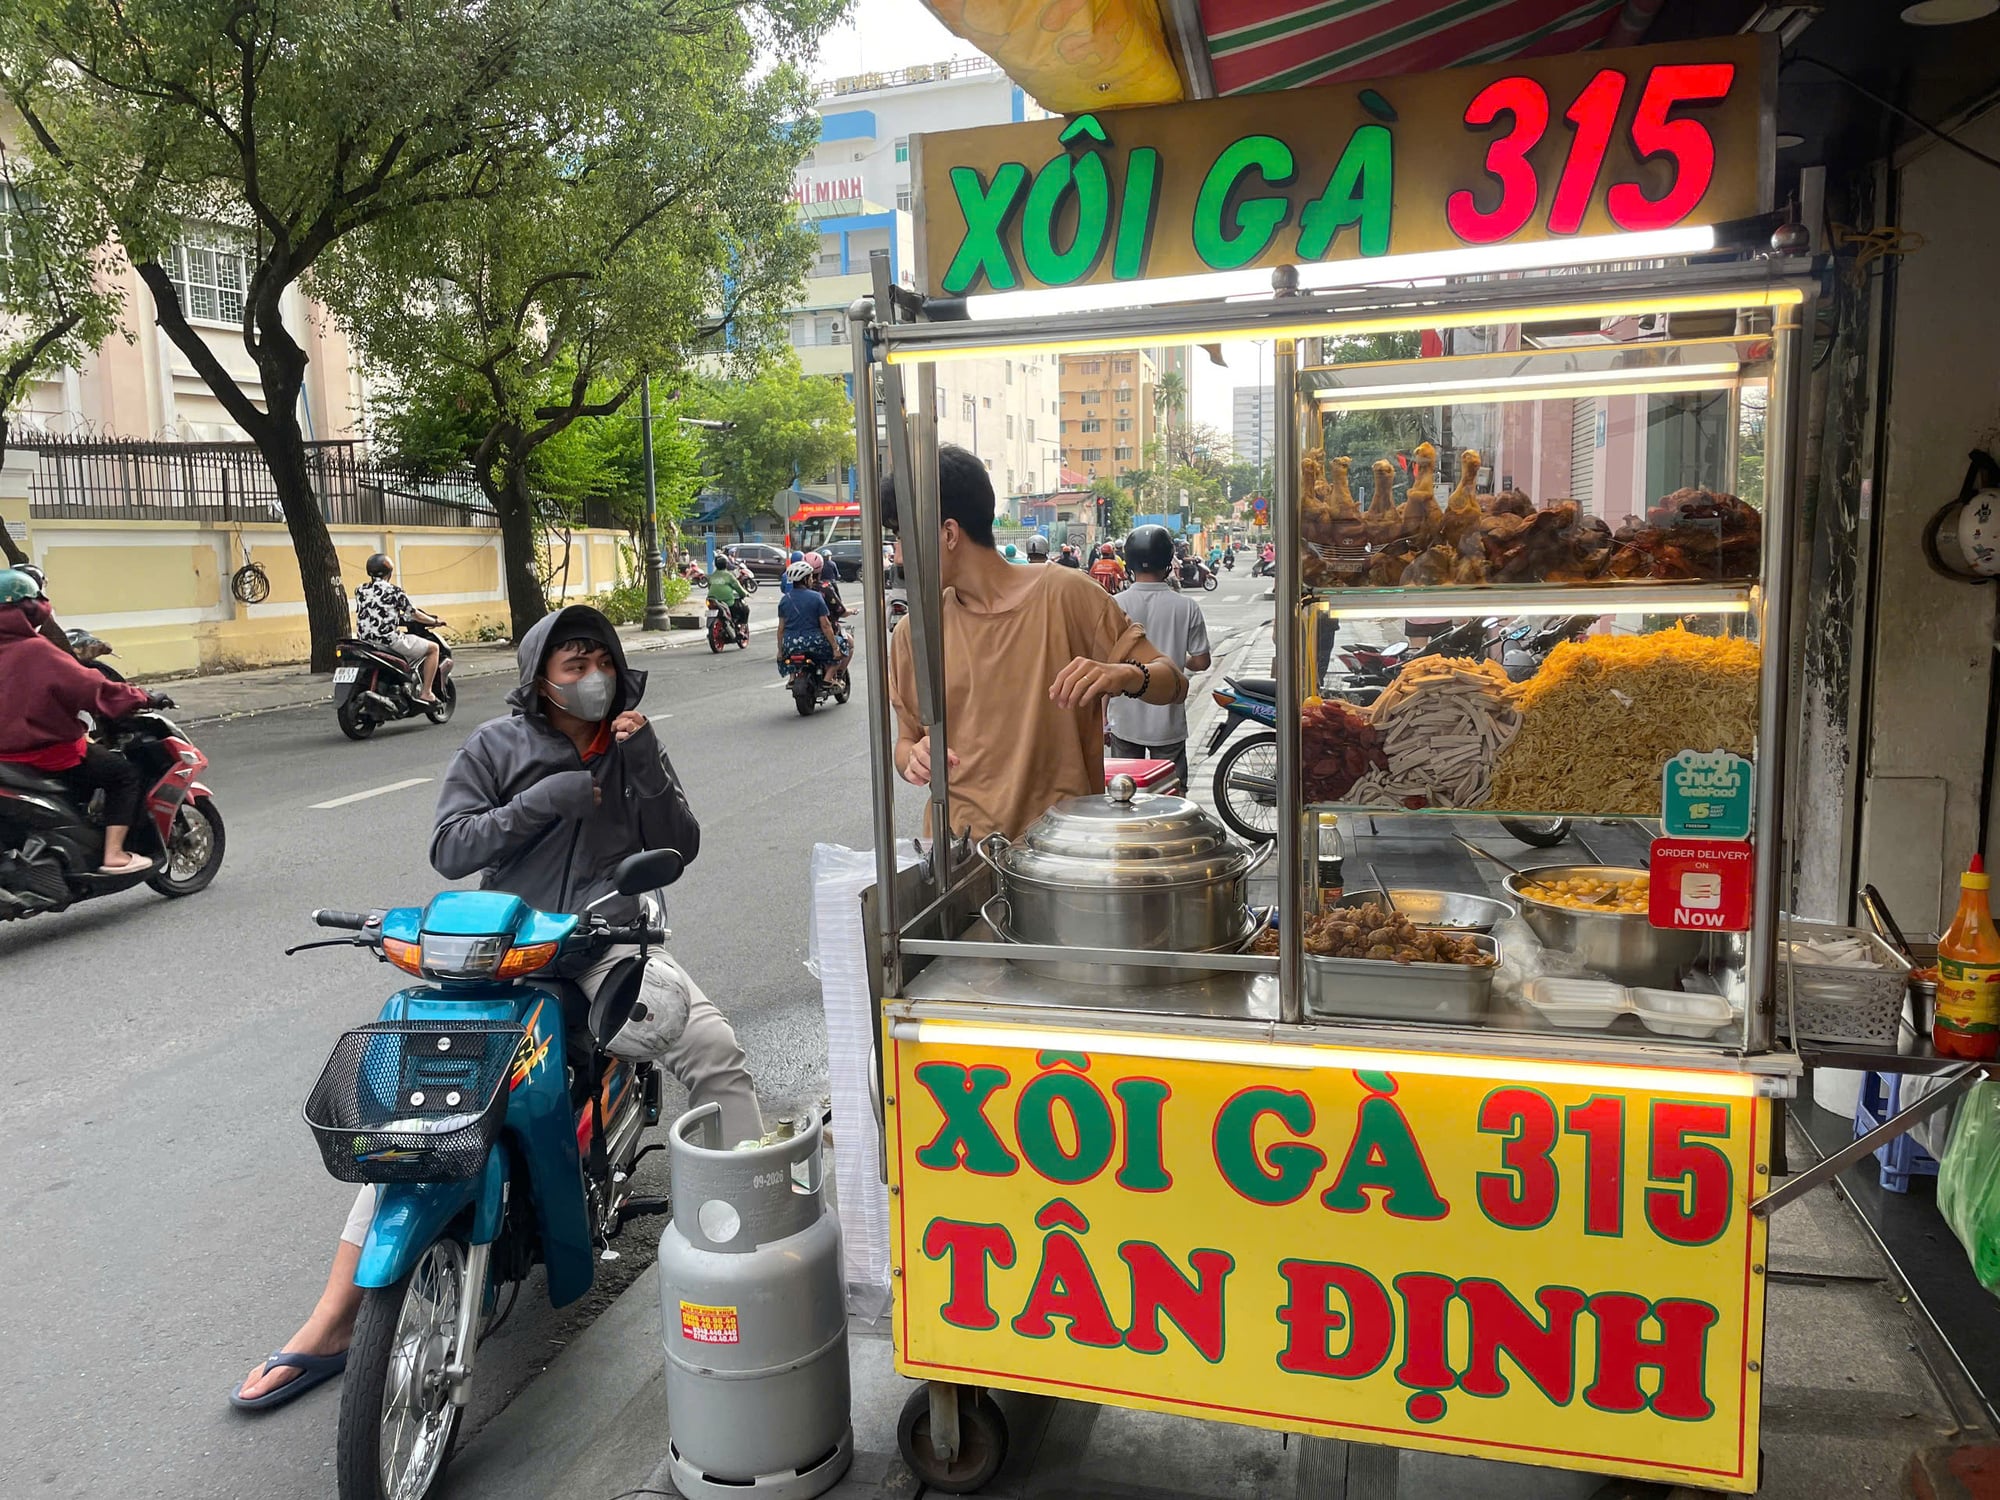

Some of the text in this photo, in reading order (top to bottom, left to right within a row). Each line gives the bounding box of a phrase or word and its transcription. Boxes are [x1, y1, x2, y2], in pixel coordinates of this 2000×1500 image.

[816, 176, 863, 203] MINH
[942, 63, 1735, 292] XÔI GÀ 315
[1689, 803, 1710, 819] 15
[1656, 848, 1750, 860] ORDER DELIVERY
[1674, 908, 1725, 927] Now
[915, 1050, 1734, 1247] XÔI GÀ 315
[922, 1197, 1720, 1424] TÂN ĐỊNH
